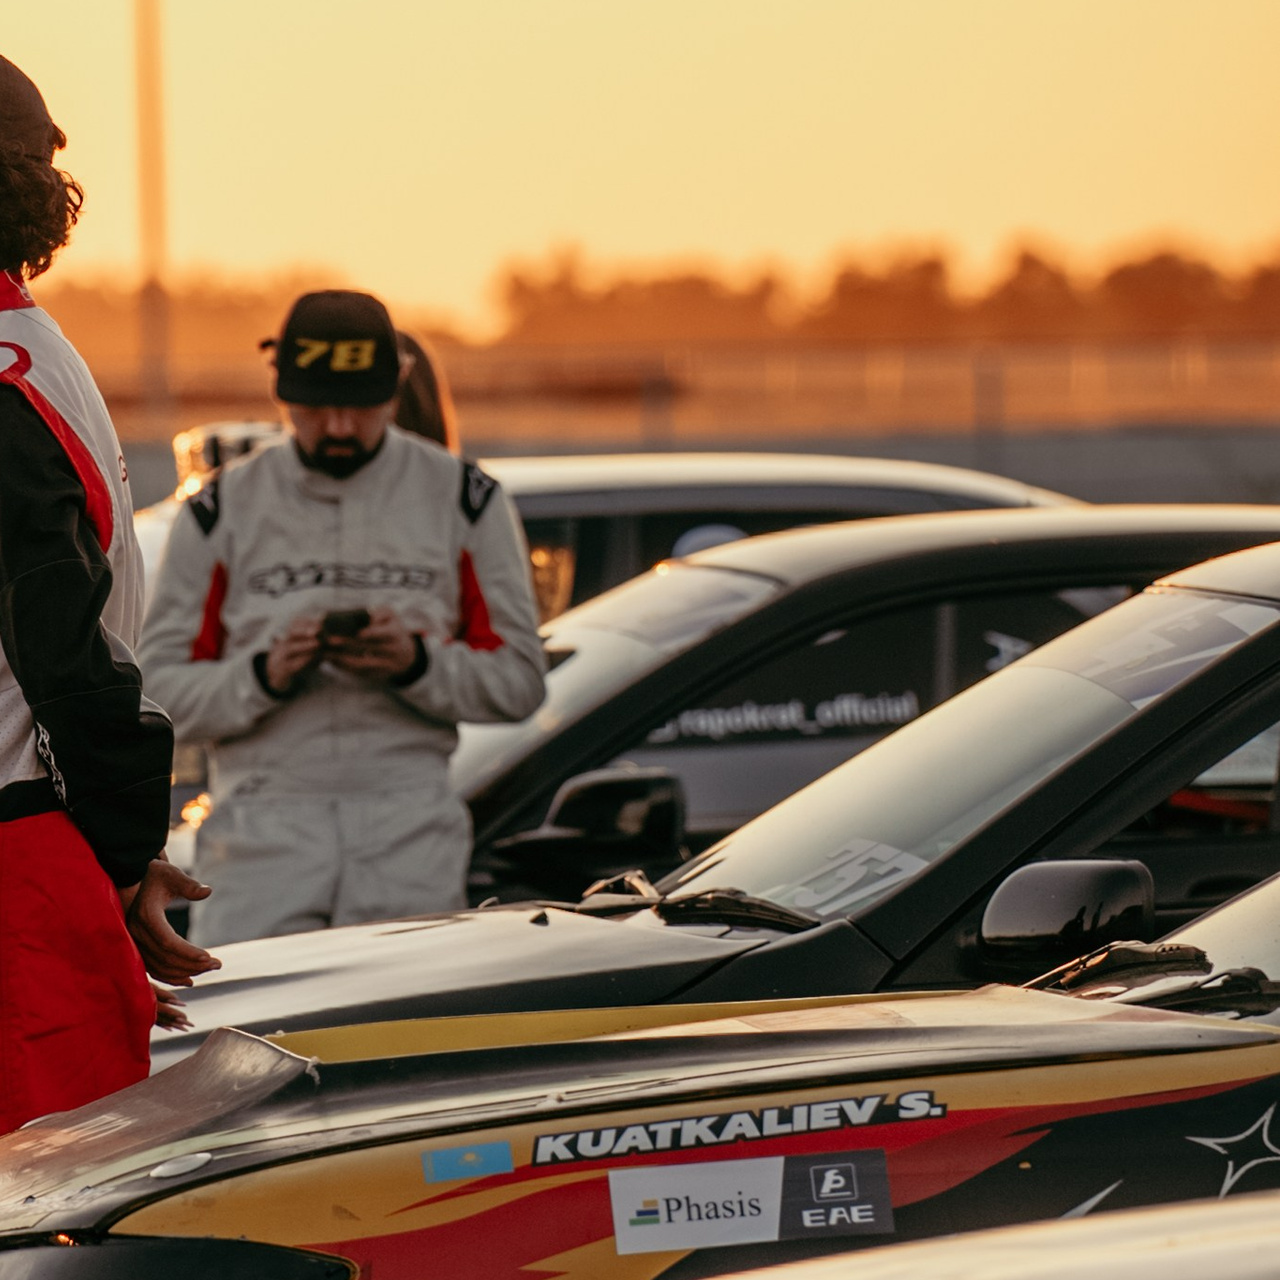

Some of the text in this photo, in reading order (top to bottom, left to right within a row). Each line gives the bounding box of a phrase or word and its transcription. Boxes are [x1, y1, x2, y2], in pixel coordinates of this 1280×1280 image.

[535, 1092, 943, 1164] KUATKALIEV S.
[663, 1191, 762, 1224] Phasis
[802, 1204, 875, 1228] EAE
